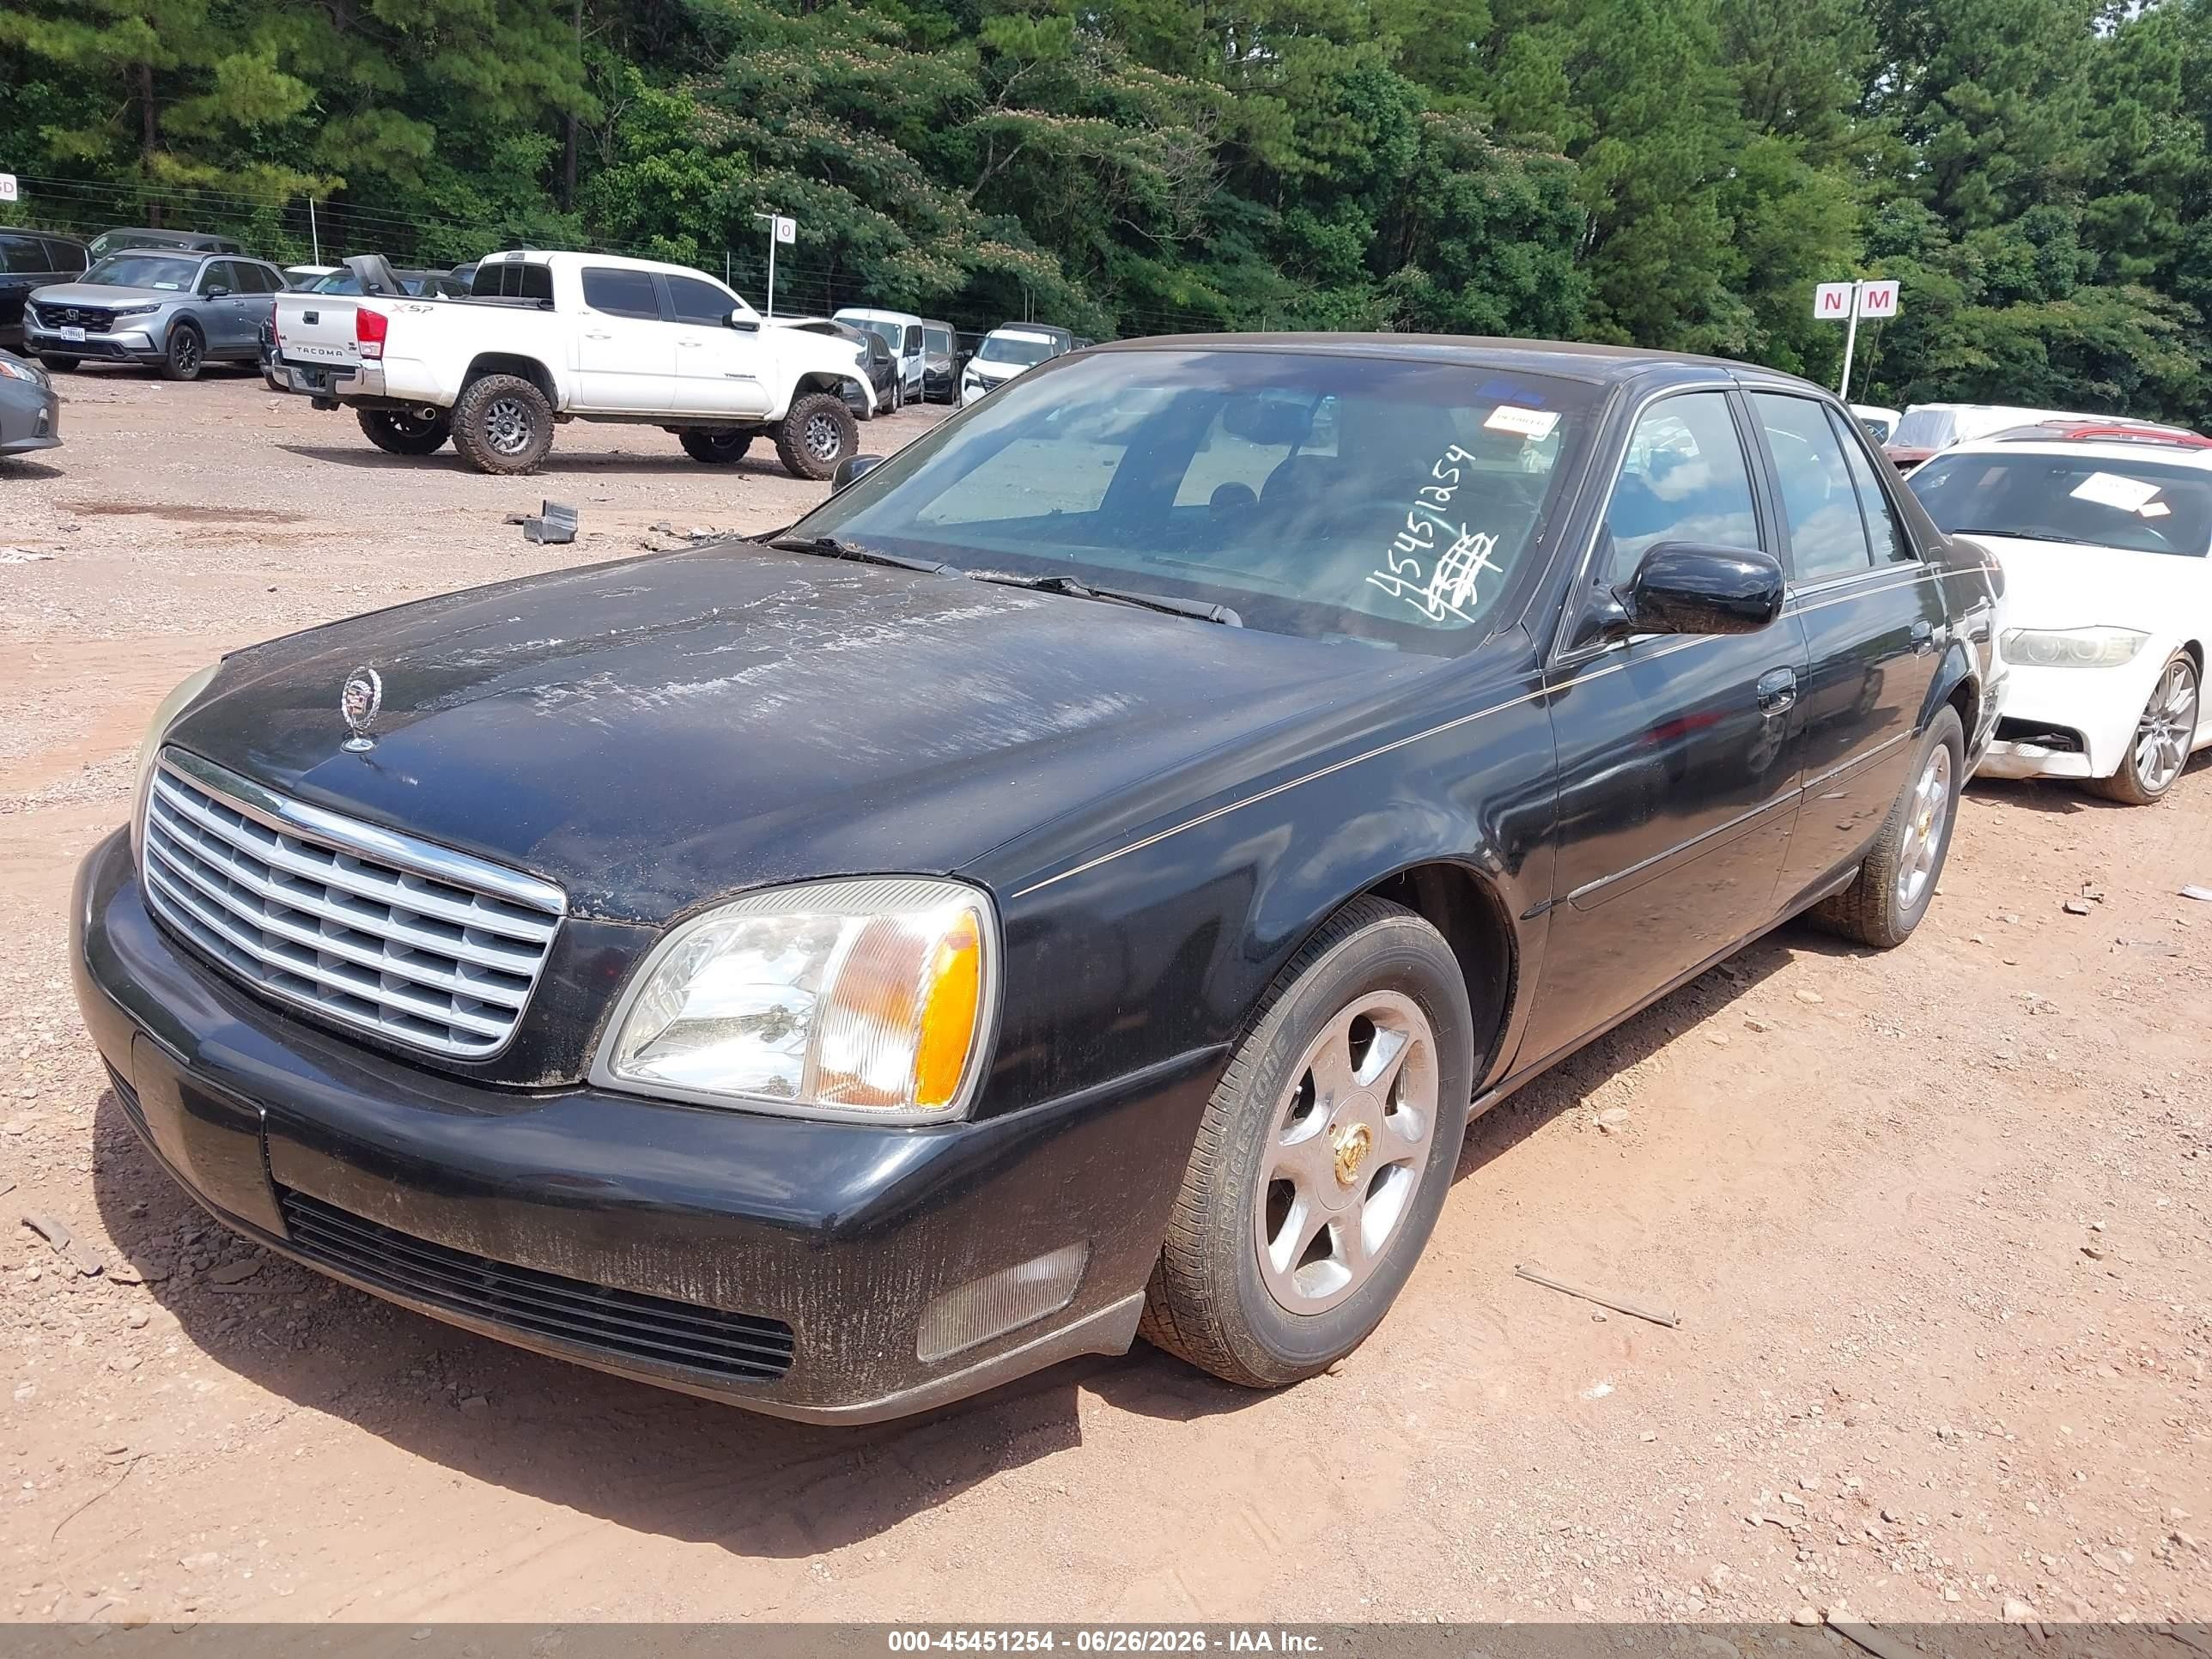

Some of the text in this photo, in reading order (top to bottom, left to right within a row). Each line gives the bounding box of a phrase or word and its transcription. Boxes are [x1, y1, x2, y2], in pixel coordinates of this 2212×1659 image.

[781, 224, 791, 237] O
[1825, 292, 1842, 310] N
[1868, 290, 1890, 309] M
[296, 346, 343, 357] TACOMA
[1364, 443, 1477, 597] 45451254
